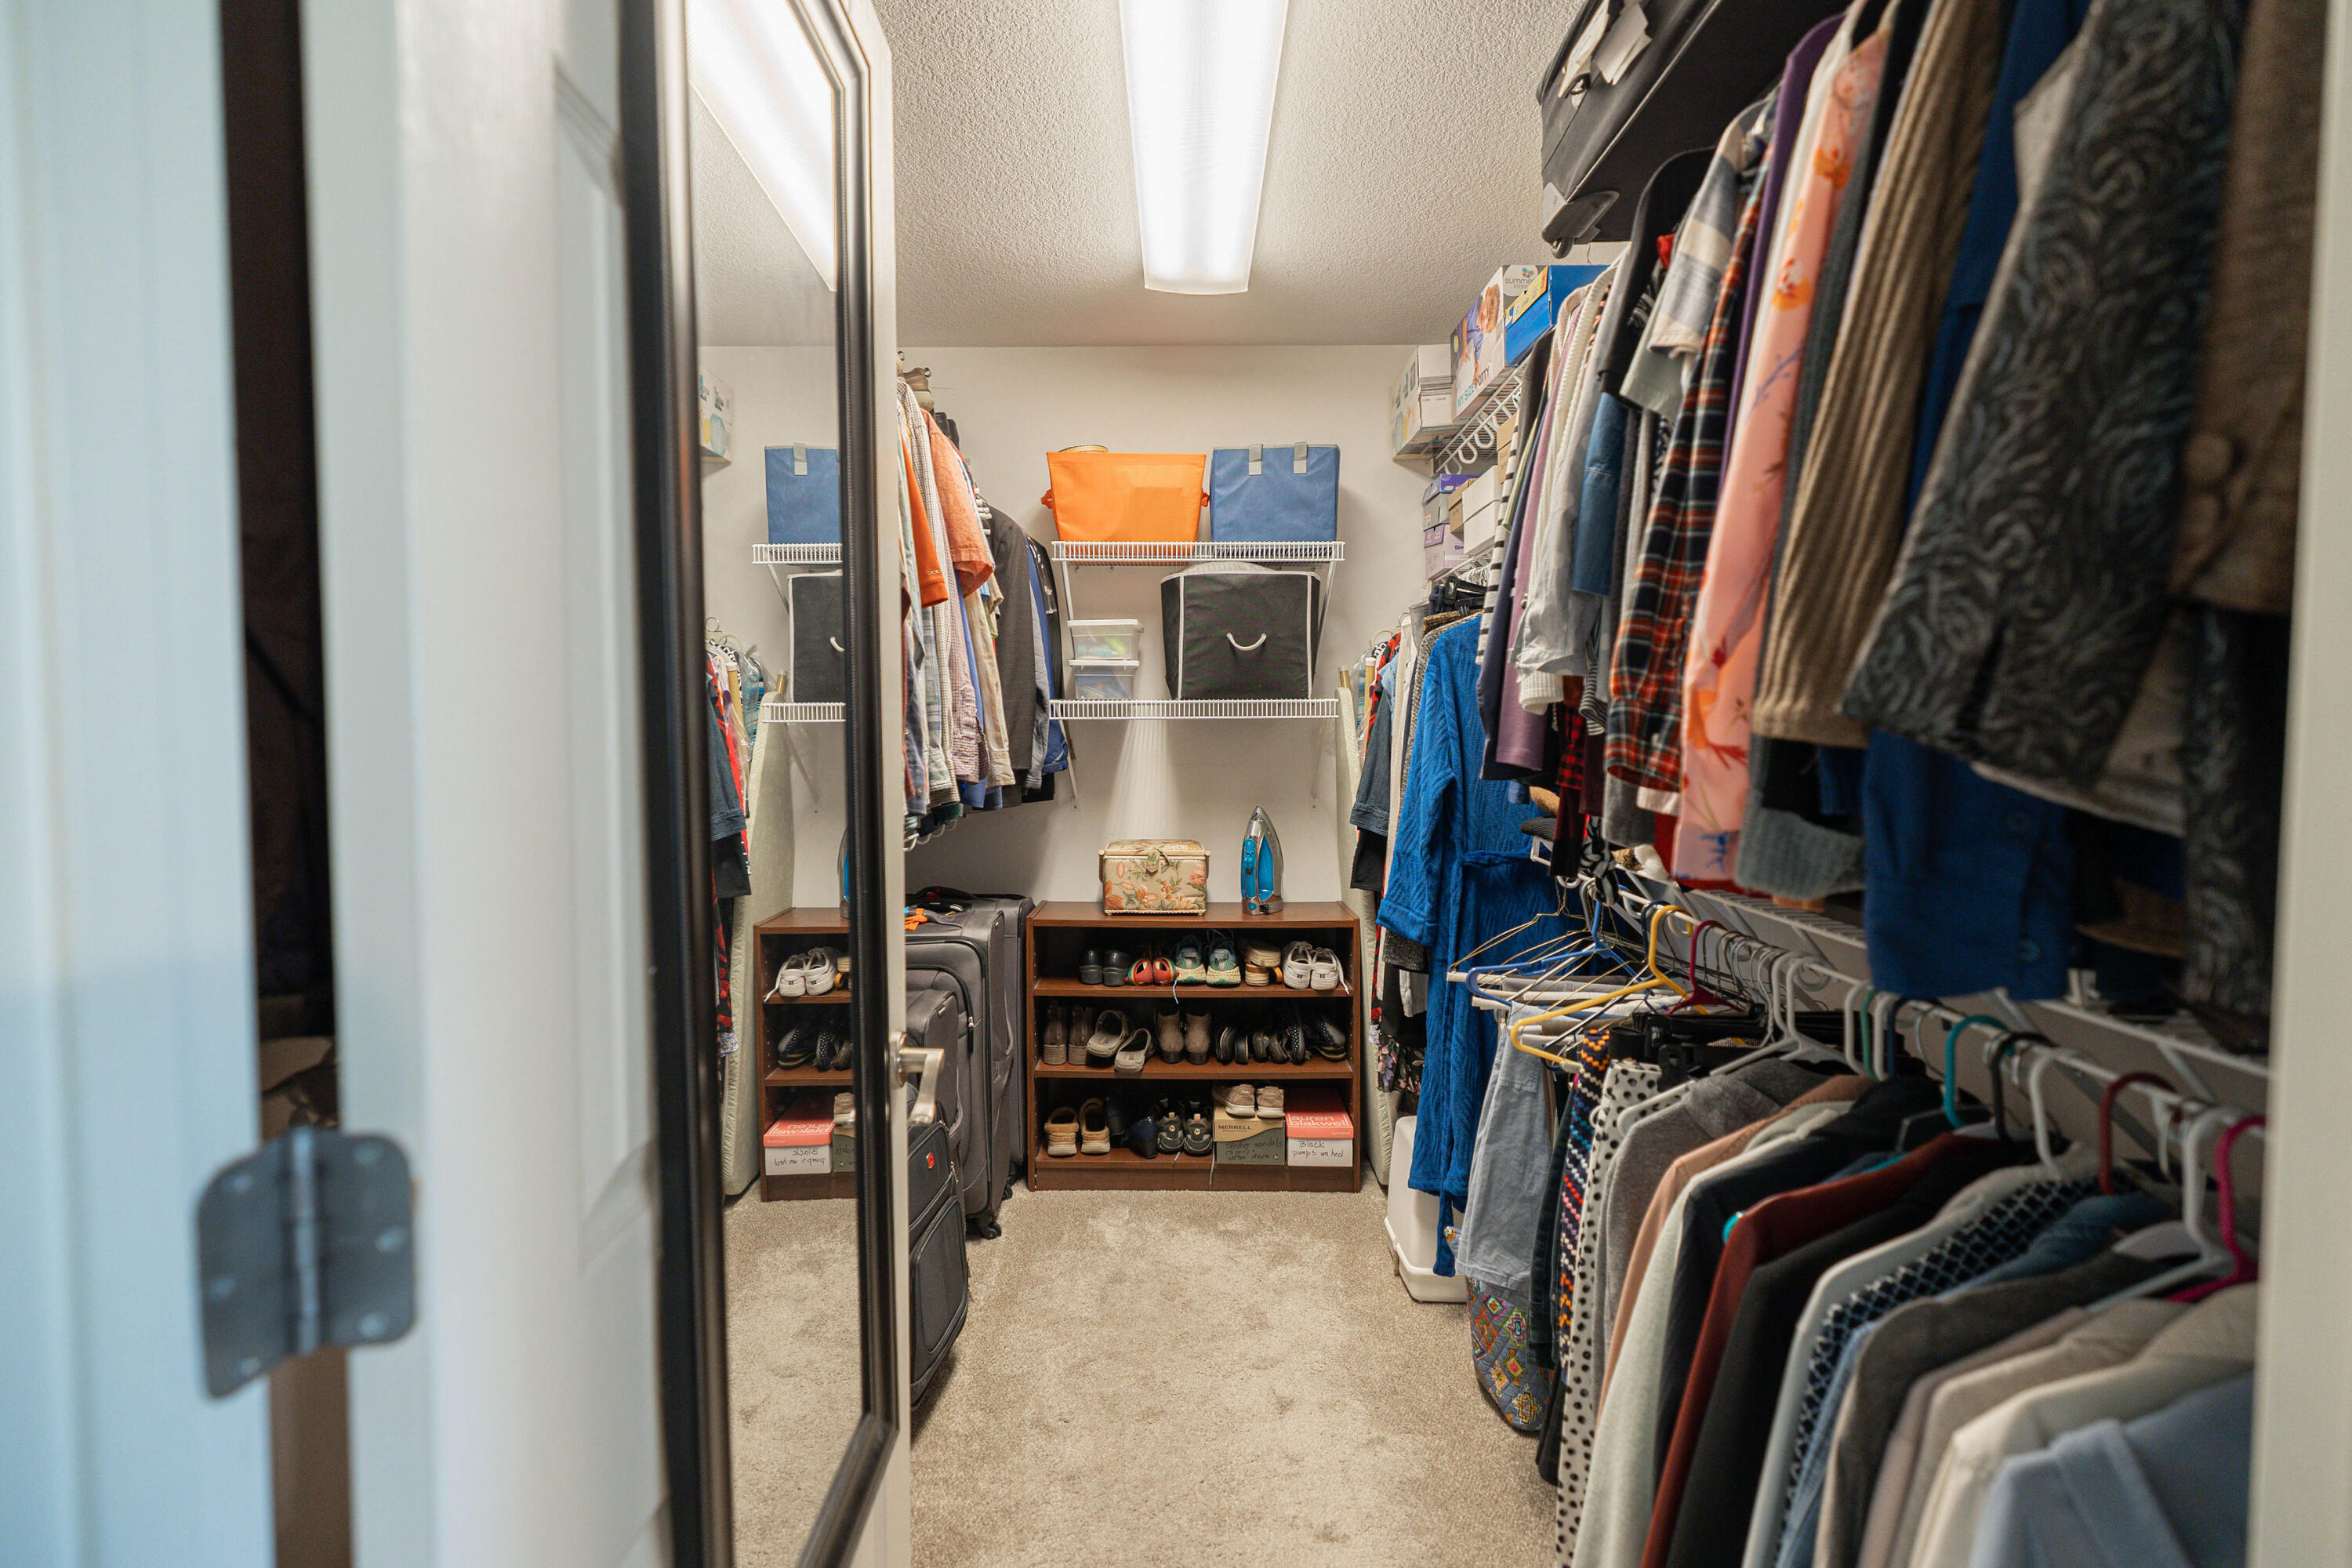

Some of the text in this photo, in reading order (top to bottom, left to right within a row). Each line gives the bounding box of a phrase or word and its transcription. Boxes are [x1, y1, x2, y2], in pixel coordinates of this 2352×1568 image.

[1288, 1112, 1334, 1122] lauren
[1290, 1114, 1349, 1127] blakwell
[1298, 1140, 1325, 1149] Black
[1292, 1150, 1316, 1159] pumps
[1330, 1149, 1344, 1158] heel
